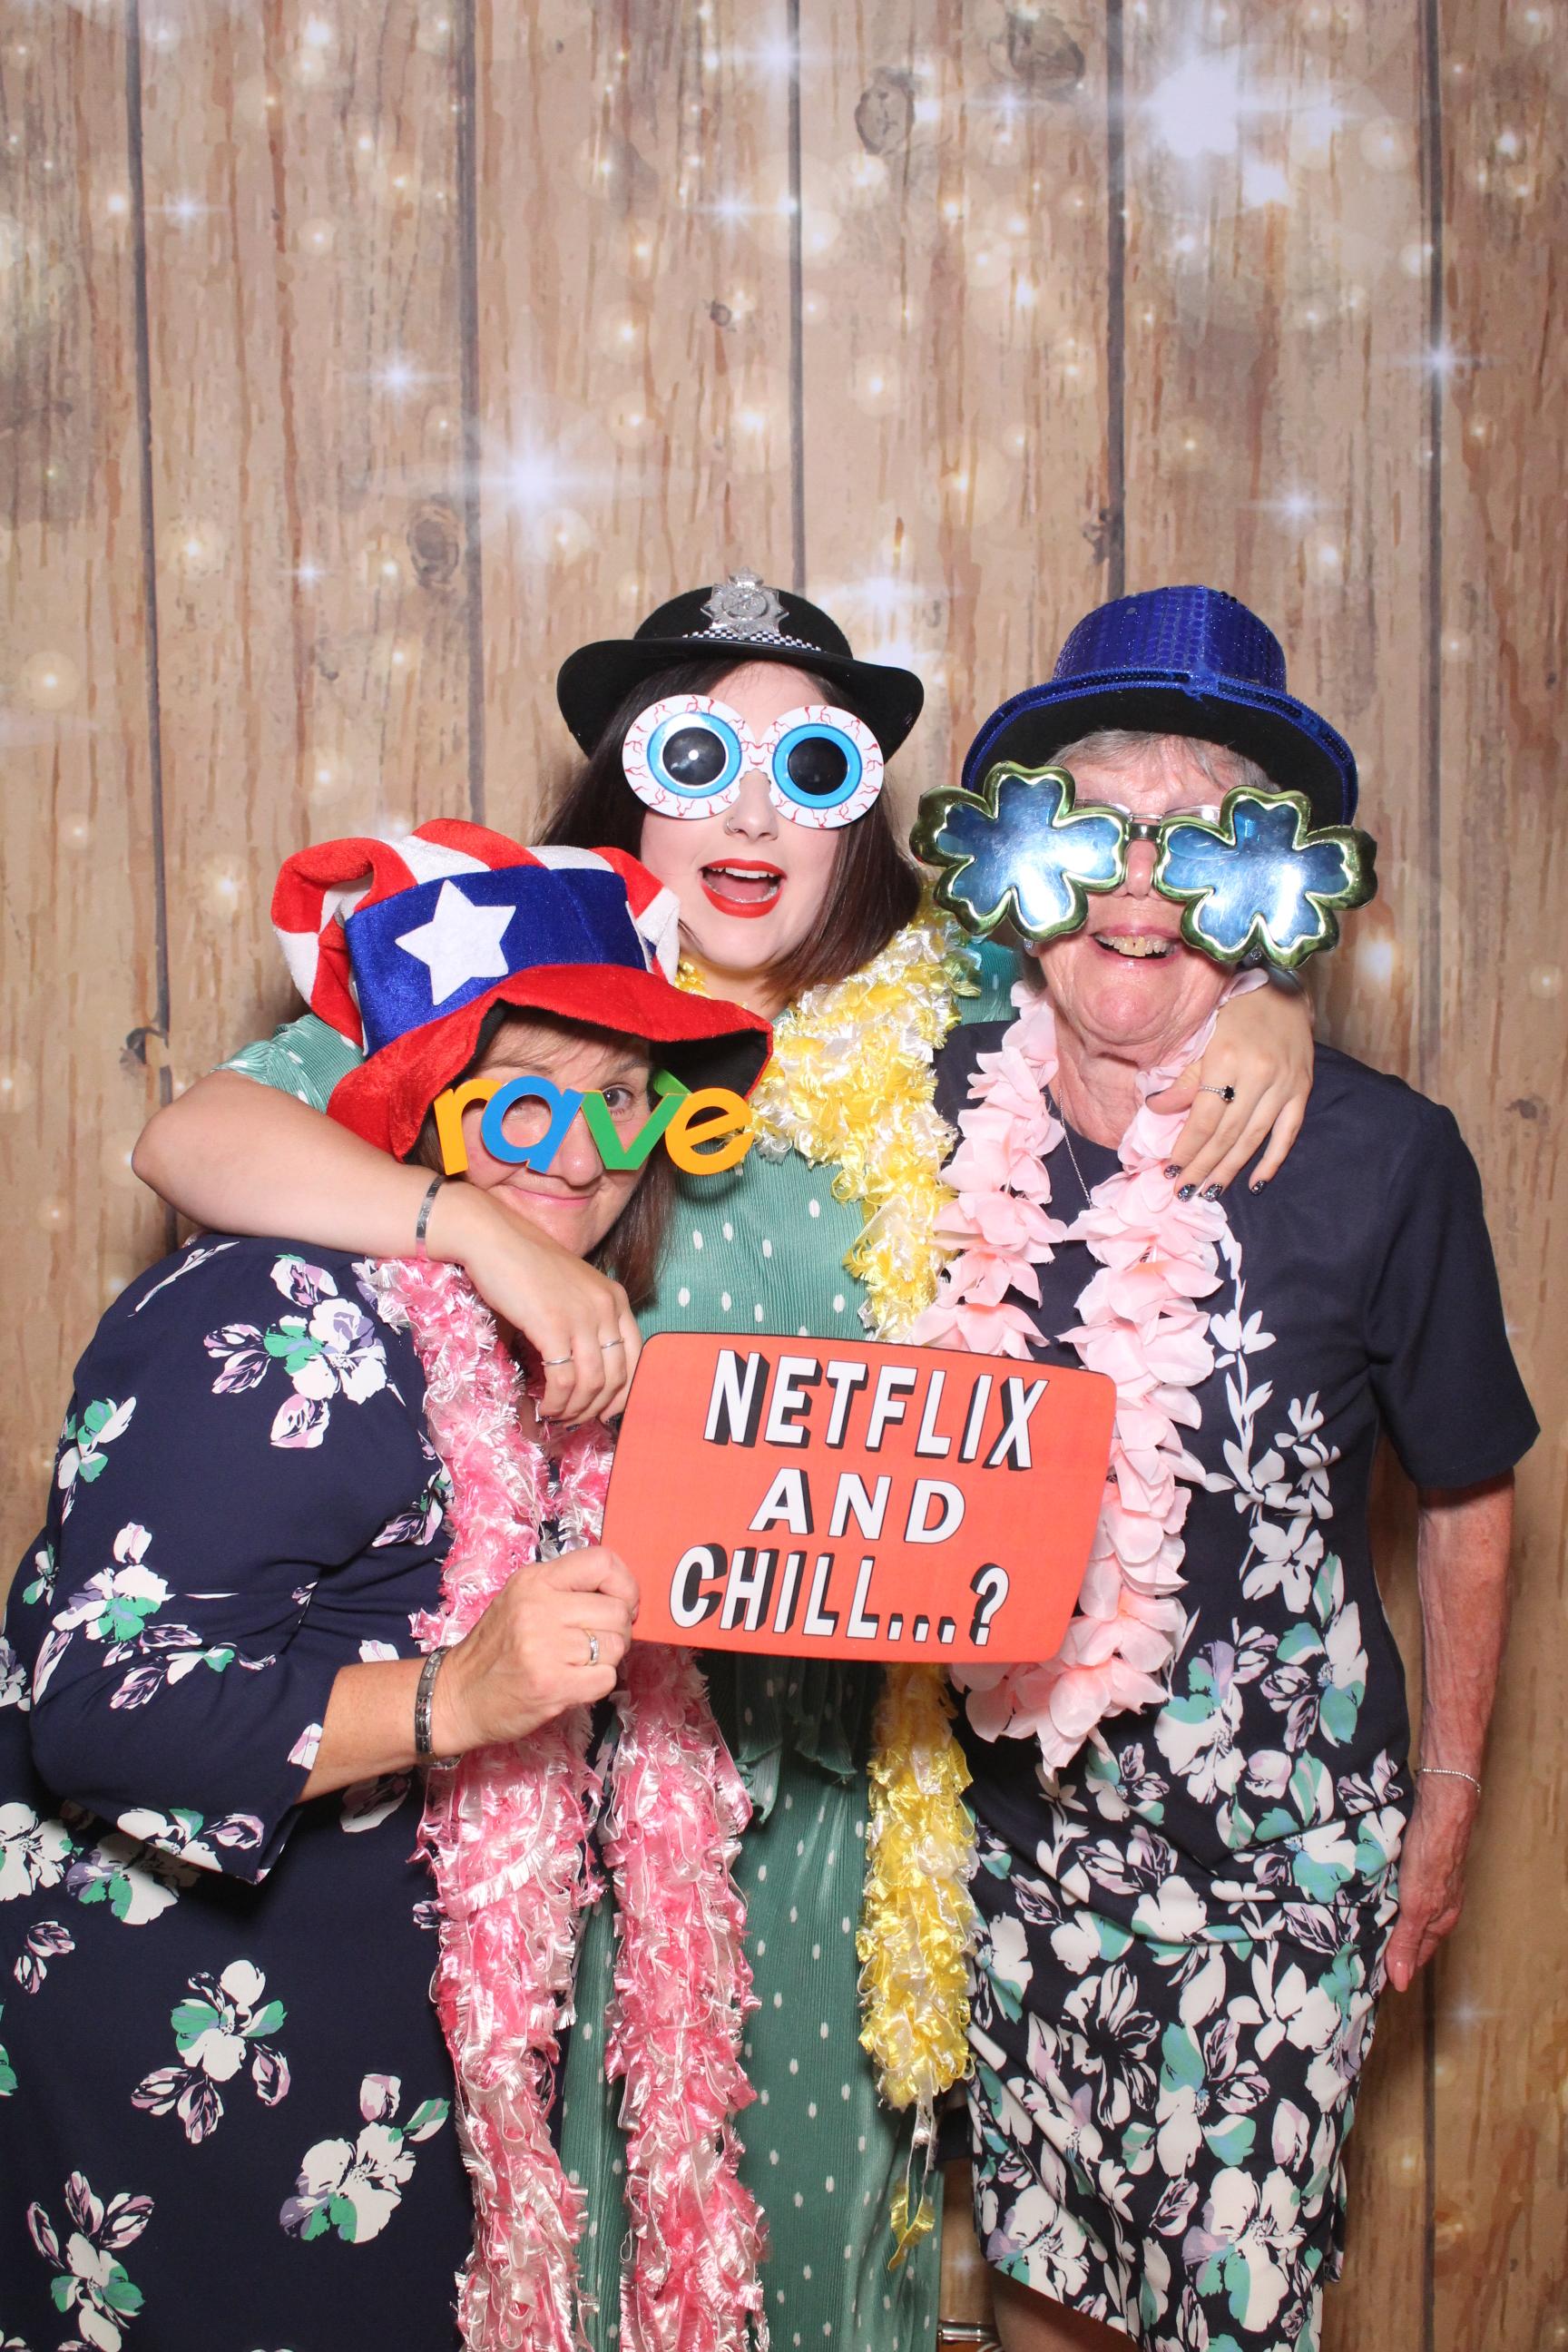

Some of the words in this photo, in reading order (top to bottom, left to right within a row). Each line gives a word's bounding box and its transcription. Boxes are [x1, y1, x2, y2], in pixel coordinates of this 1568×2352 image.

[433, 1074, 755, 1176] rave
[702, 1348, 1049, 1471] NETFLIX
[748, 1466, 966, 1544] AND
